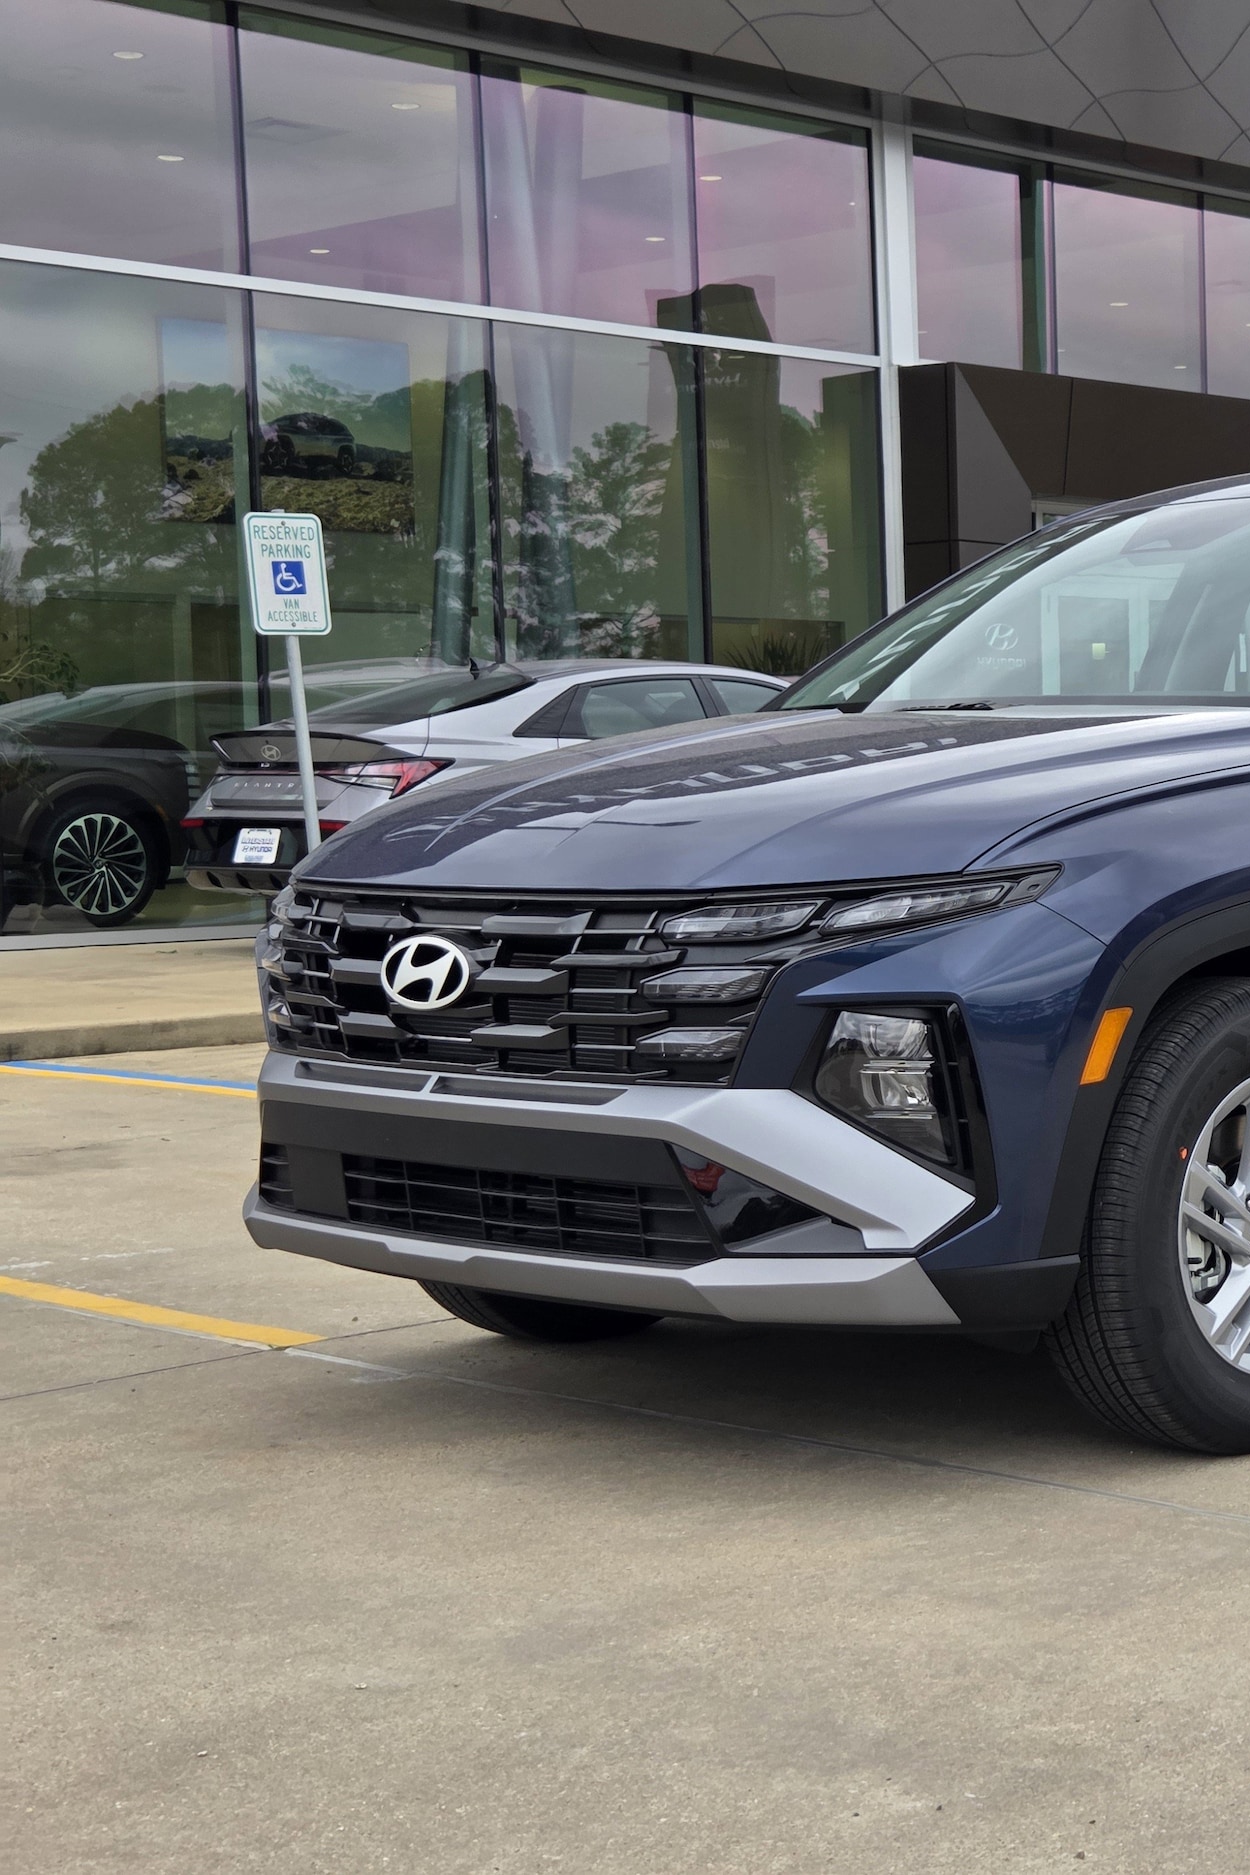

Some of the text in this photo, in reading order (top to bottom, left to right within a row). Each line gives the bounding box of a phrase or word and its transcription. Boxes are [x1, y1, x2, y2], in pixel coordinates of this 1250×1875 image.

[253, 525, 315, 540] RESERVED
[261, 544, 311, 559] PARKING
[283, 598, 300, 609] VAN
[268, 611, 318, 622] ACCESSIBLE
